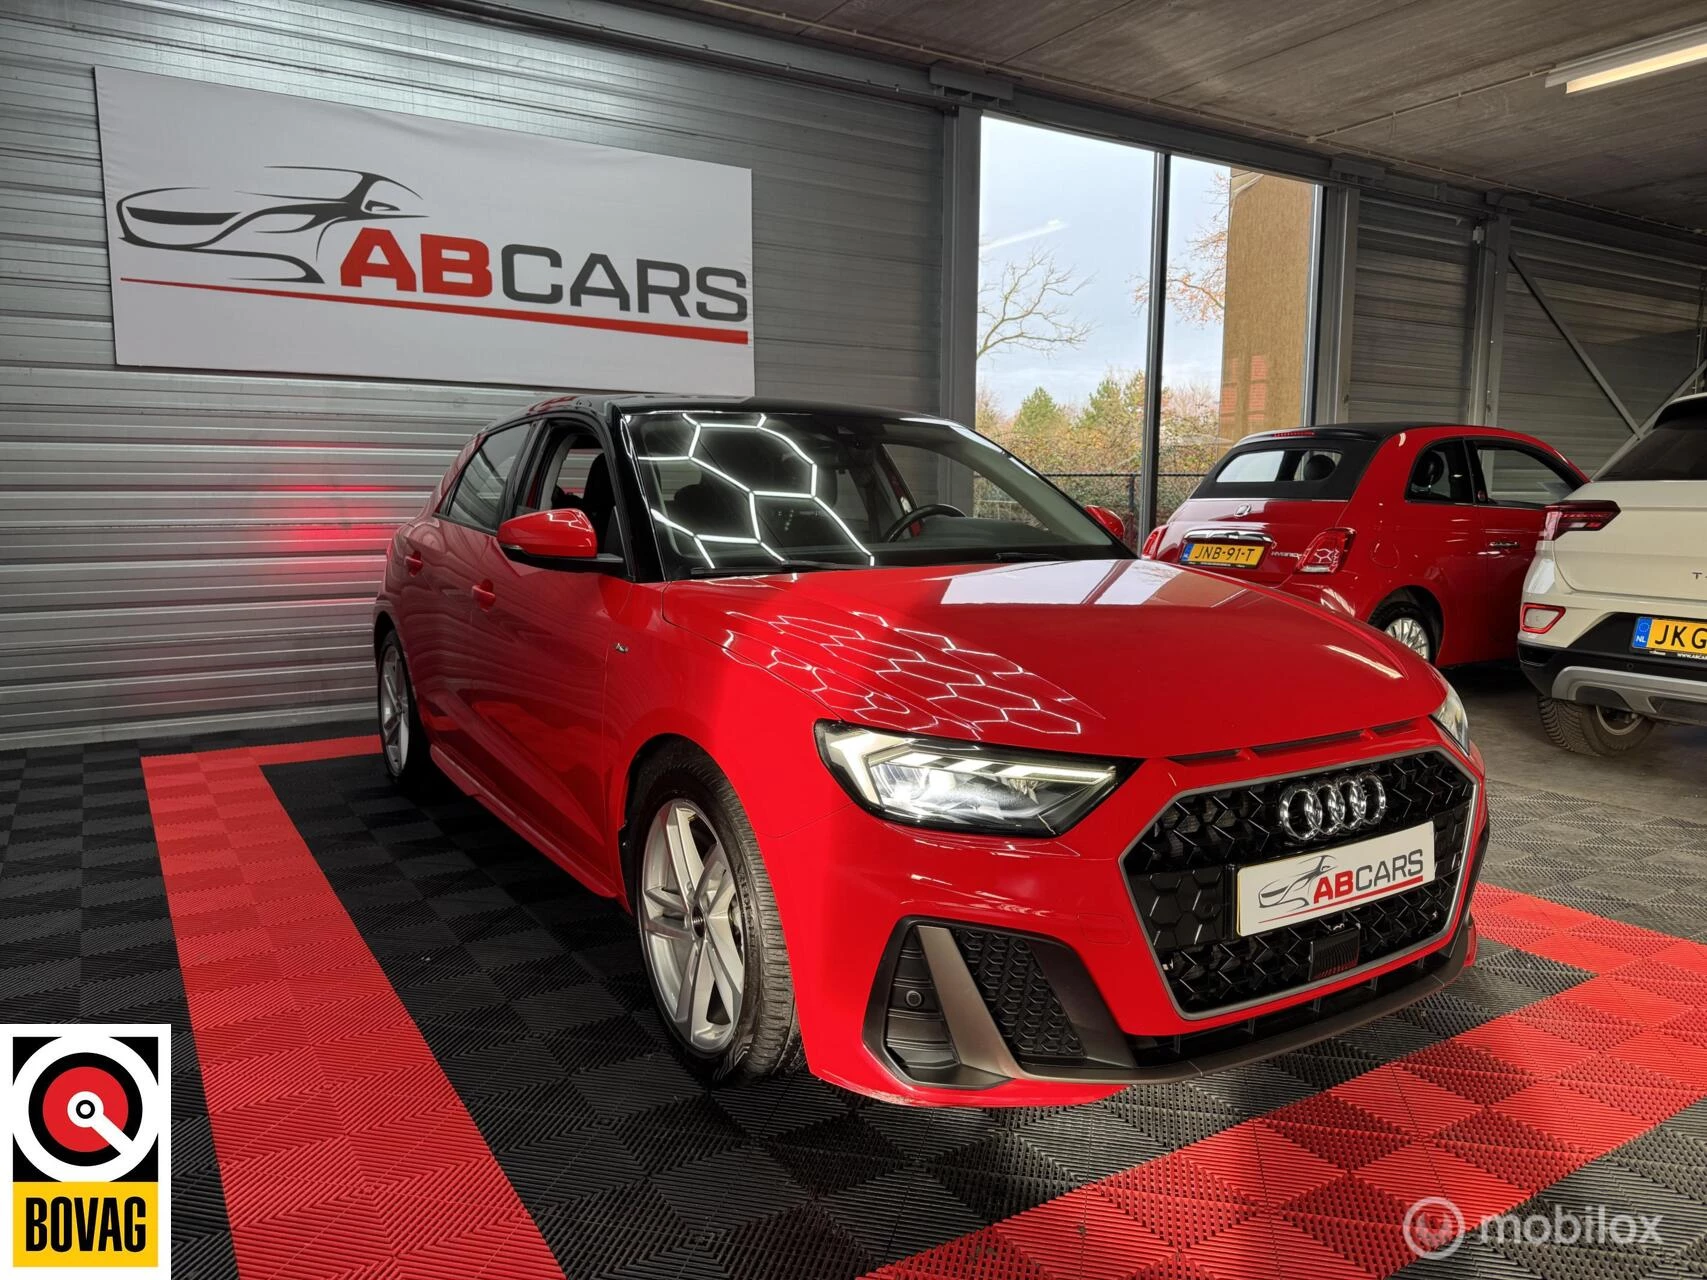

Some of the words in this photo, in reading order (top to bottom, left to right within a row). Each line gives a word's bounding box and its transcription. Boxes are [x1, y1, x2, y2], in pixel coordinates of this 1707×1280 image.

[340, 227, 748, 322] ABCARS
[1195, 546, 1256, 562] JNB-91-T
[1636, 635, 1646, 643] NL
[1313, 849, 1423, 904] ABCARS
